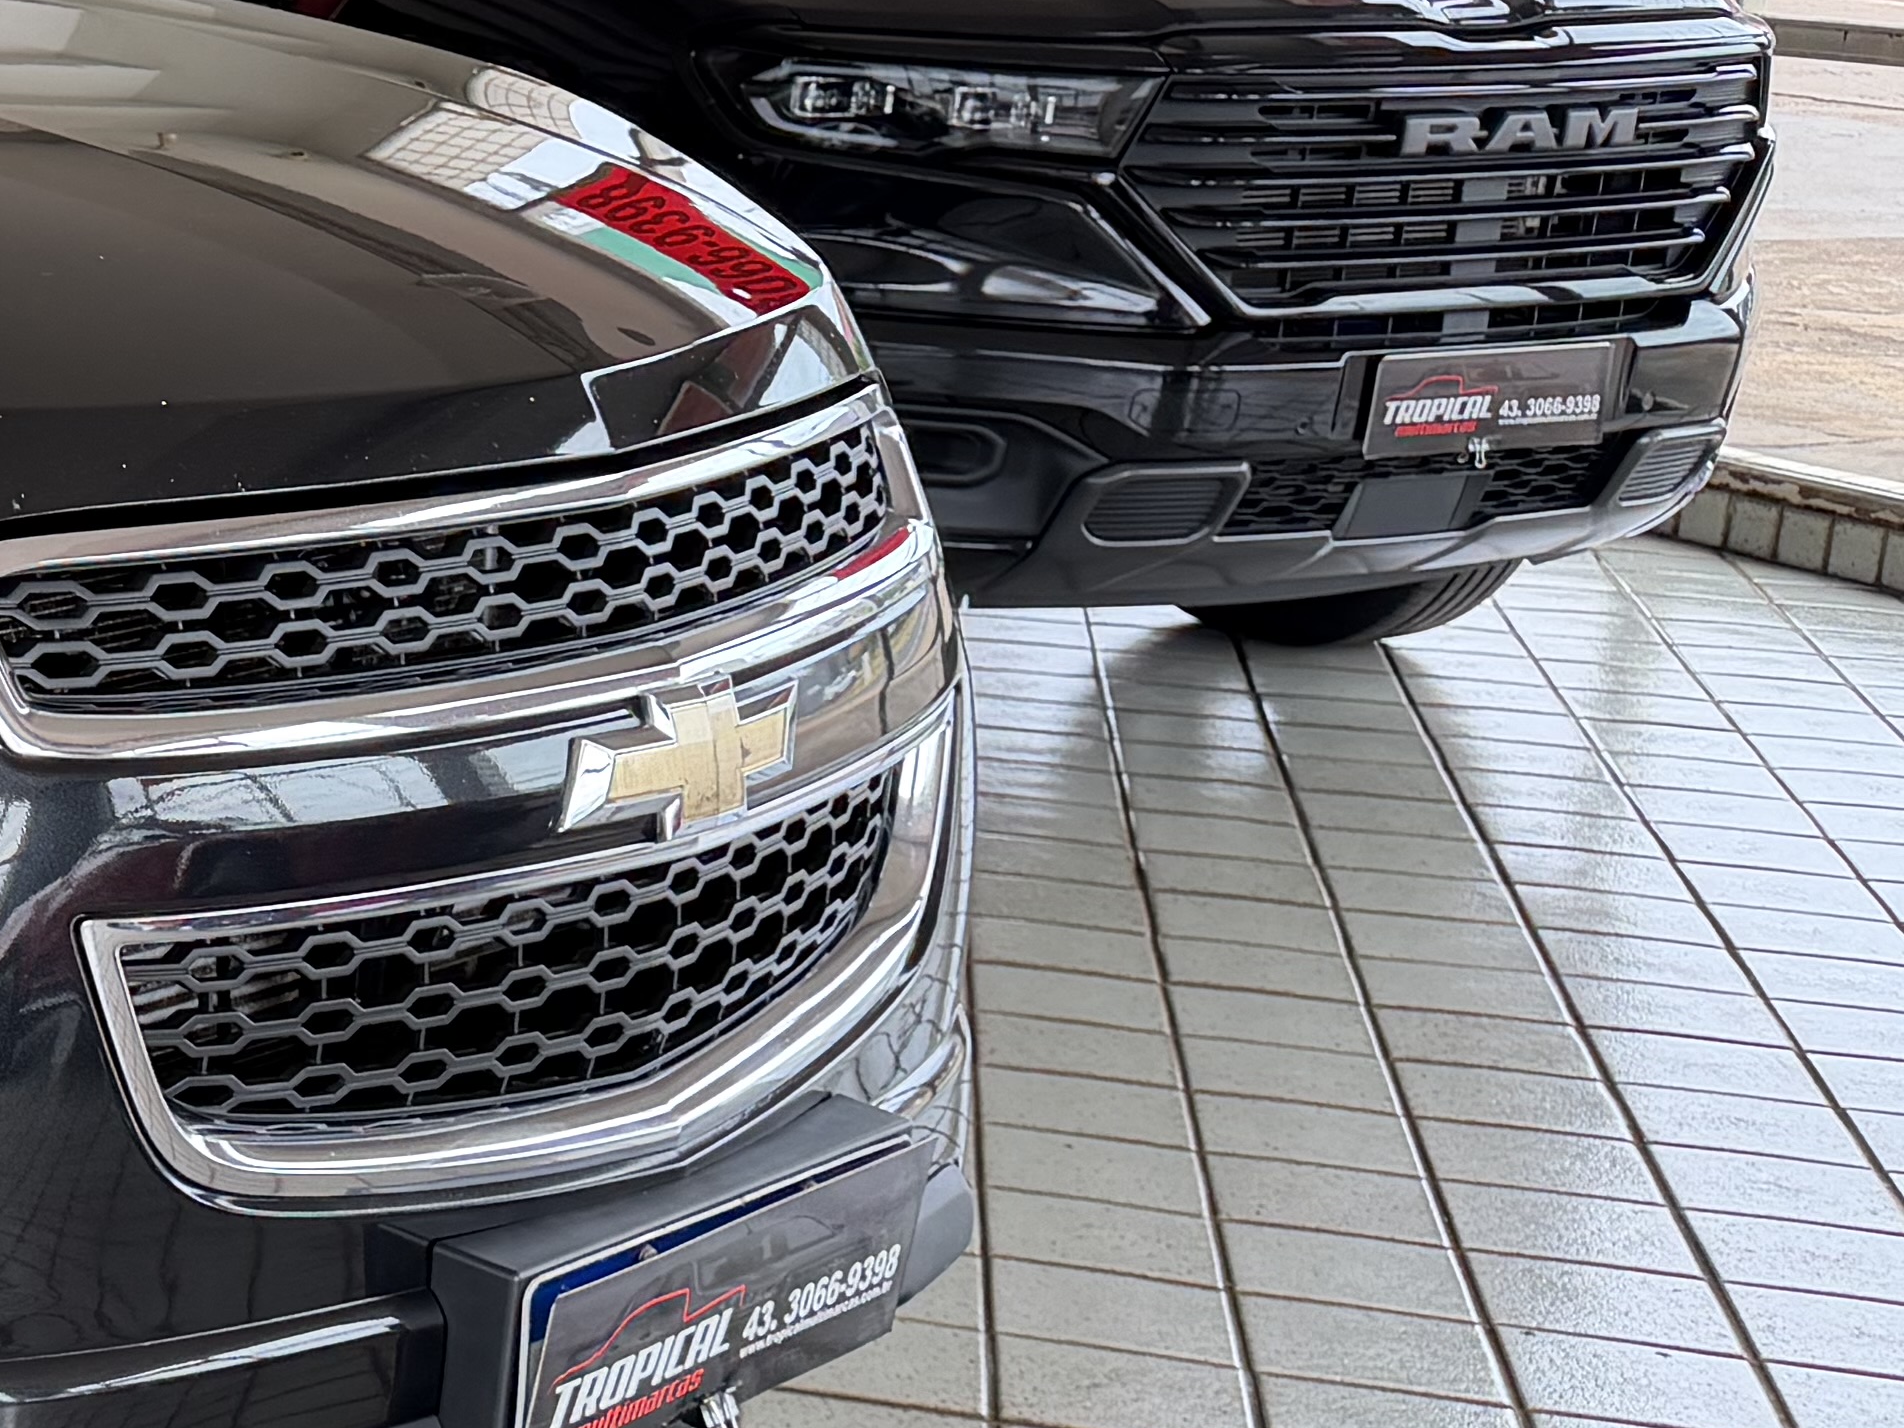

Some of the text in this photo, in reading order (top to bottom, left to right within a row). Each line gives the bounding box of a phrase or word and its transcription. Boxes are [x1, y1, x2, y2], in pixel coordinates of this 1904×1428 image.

[1403, 106, 1639, 157] RAM
[1383, 393, 1493, 426] TROPICAL
[1498, 394, 1601, 417] 43. 3066-9398
[742, 1243, 902, 1341] 43. 3066-9398
